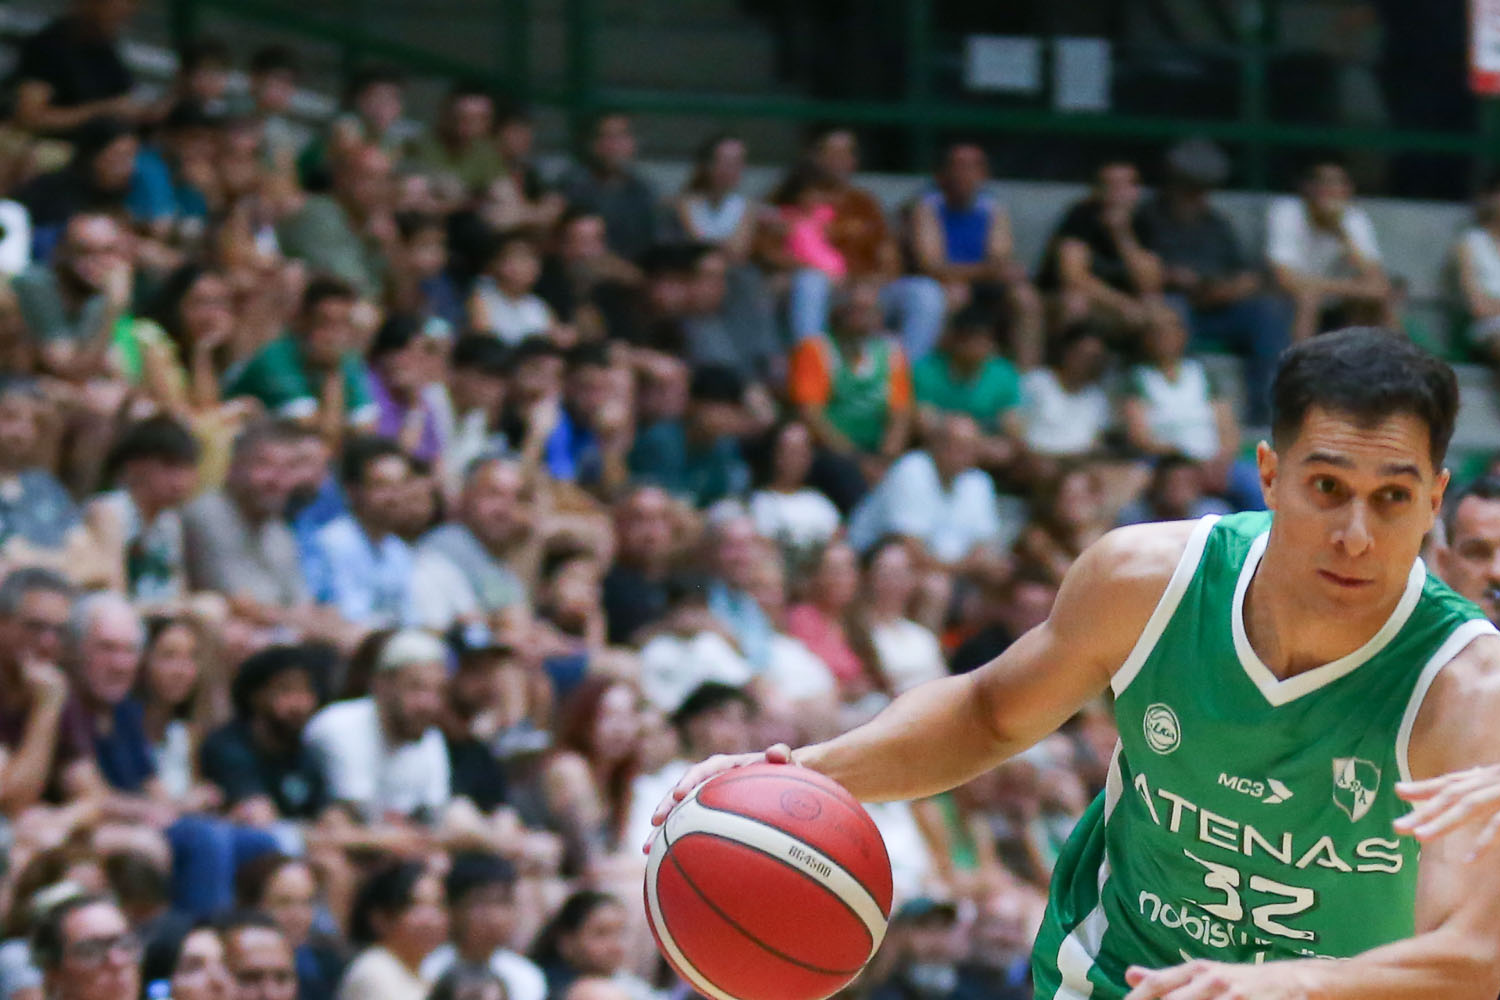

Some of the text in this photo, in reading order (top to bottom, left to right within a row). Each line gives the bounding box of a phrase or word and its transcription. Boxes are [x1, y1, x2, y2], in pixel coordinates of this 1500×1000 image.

[1134, 772, 1403, 874] ATENAS
[1217, 772, 1264, 797] MC3
[1182, 848, 1316, 942] 32
